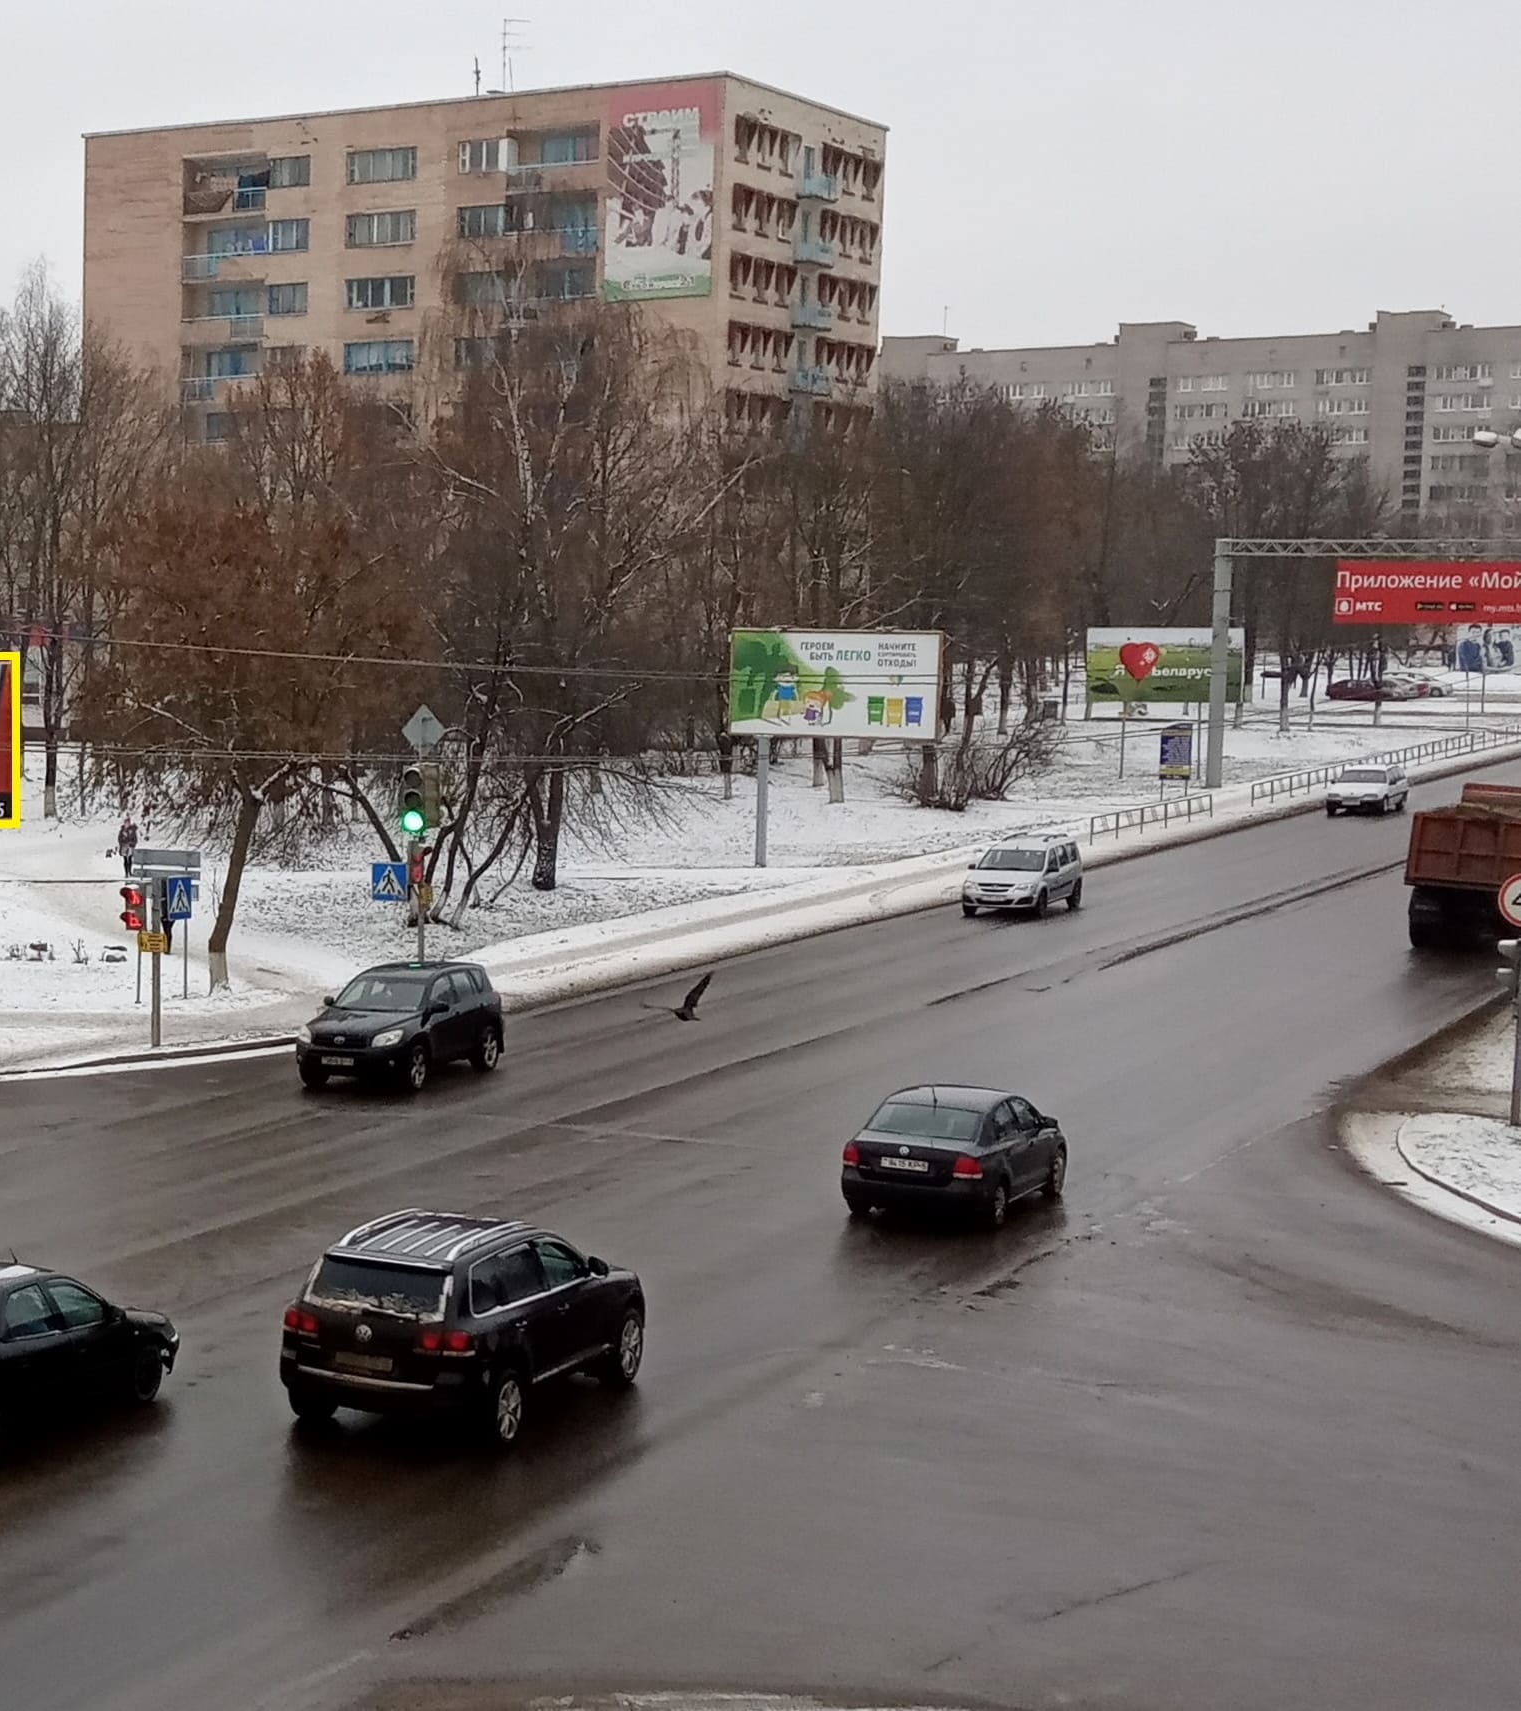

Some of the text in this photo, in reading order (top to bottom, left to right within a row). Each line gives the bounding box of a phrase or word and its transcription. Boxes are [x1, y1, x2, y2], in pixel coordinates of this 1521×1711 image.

[622, 107, 700, 128] СТРОИМ
[1336, 571, 1463, 592] Приложение
[1355, 601, 1382, 612] МТС
[800, 642, 871, 662] ГЕРОЕМ БЫТЬ ЛЕГКО
[878, 642, 917, 651] НАЧНИТЕ
[877, 659, 917, 669] ОТХОДЫ!
[1111, 664, 1212, 680] Я Беларус
